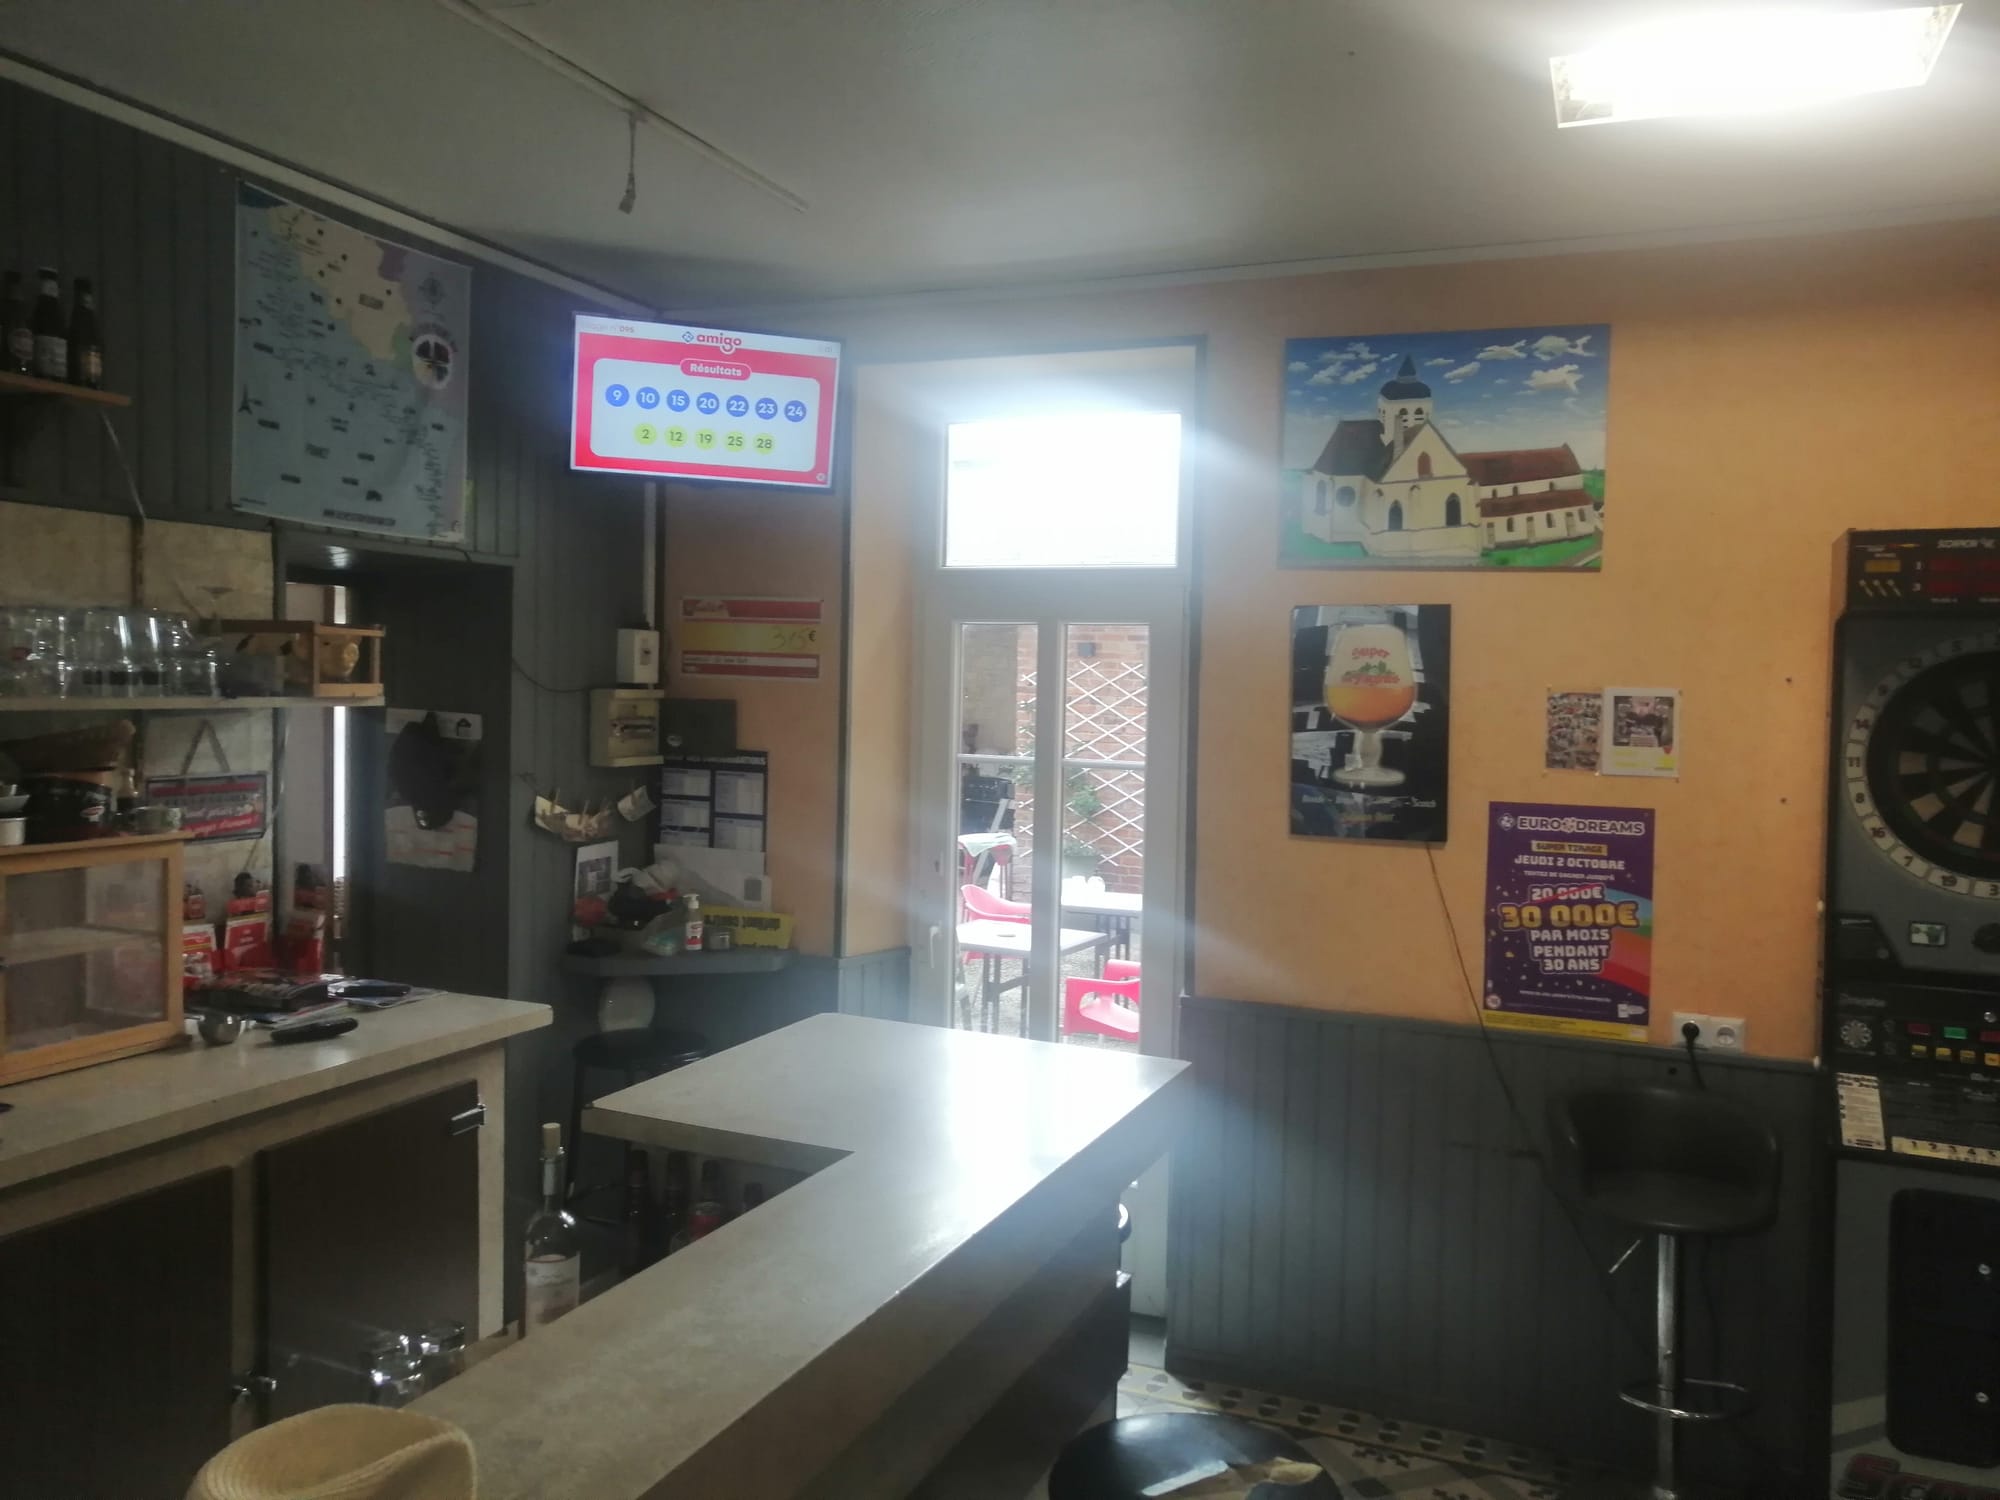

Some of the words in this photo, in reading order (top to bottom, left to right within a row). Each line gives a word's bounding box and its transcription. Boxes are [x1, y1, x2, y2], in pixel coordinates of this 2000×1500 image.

[696, 333, 742, 354] amigo
[690, 363, 742, 377] Résultats
[612, 390, 622, 401] 9
[640, 392, 656, 404] 10
[672, 395, 685, 406] 15
[700, 398, 717, 409] 20
[730, 401, 746, 412] 22
[758, 404, 774, 414] 23
[788, 406, 804, 417] 24
[642, 429, 650, 440] 2
[670, 431, 683, 442] 12
[699, 433, 712, 444] 19
[728, 436, 743, 447] 25
[756, 438, 773, 449] 28
[1856, 793, 1865, 804] 8
[1871, 827, 1886, 838] 16
[1514, 855, 1554, 865] JEUDI
[1557, 857, 1564, 866] 2
[1567, 858, 1625, 870] OCTOBRE
[1904, 856, 1913, 866] 7
[1531, 886, 1552, 900] 20
[1990, 884, 1999, 896] 3
[1500, 906, 1542, 928] 30
[1550, 904, 1639, 927] 000€
[1530, 930, 1562, 941] PAR
[1567, 930, 1610, 941] MOIS
[1534, 946, 1609, 957] PENDANT
[1544, 959, 1564, 970] 30
[1568, 959, 1600, 970] ANS
